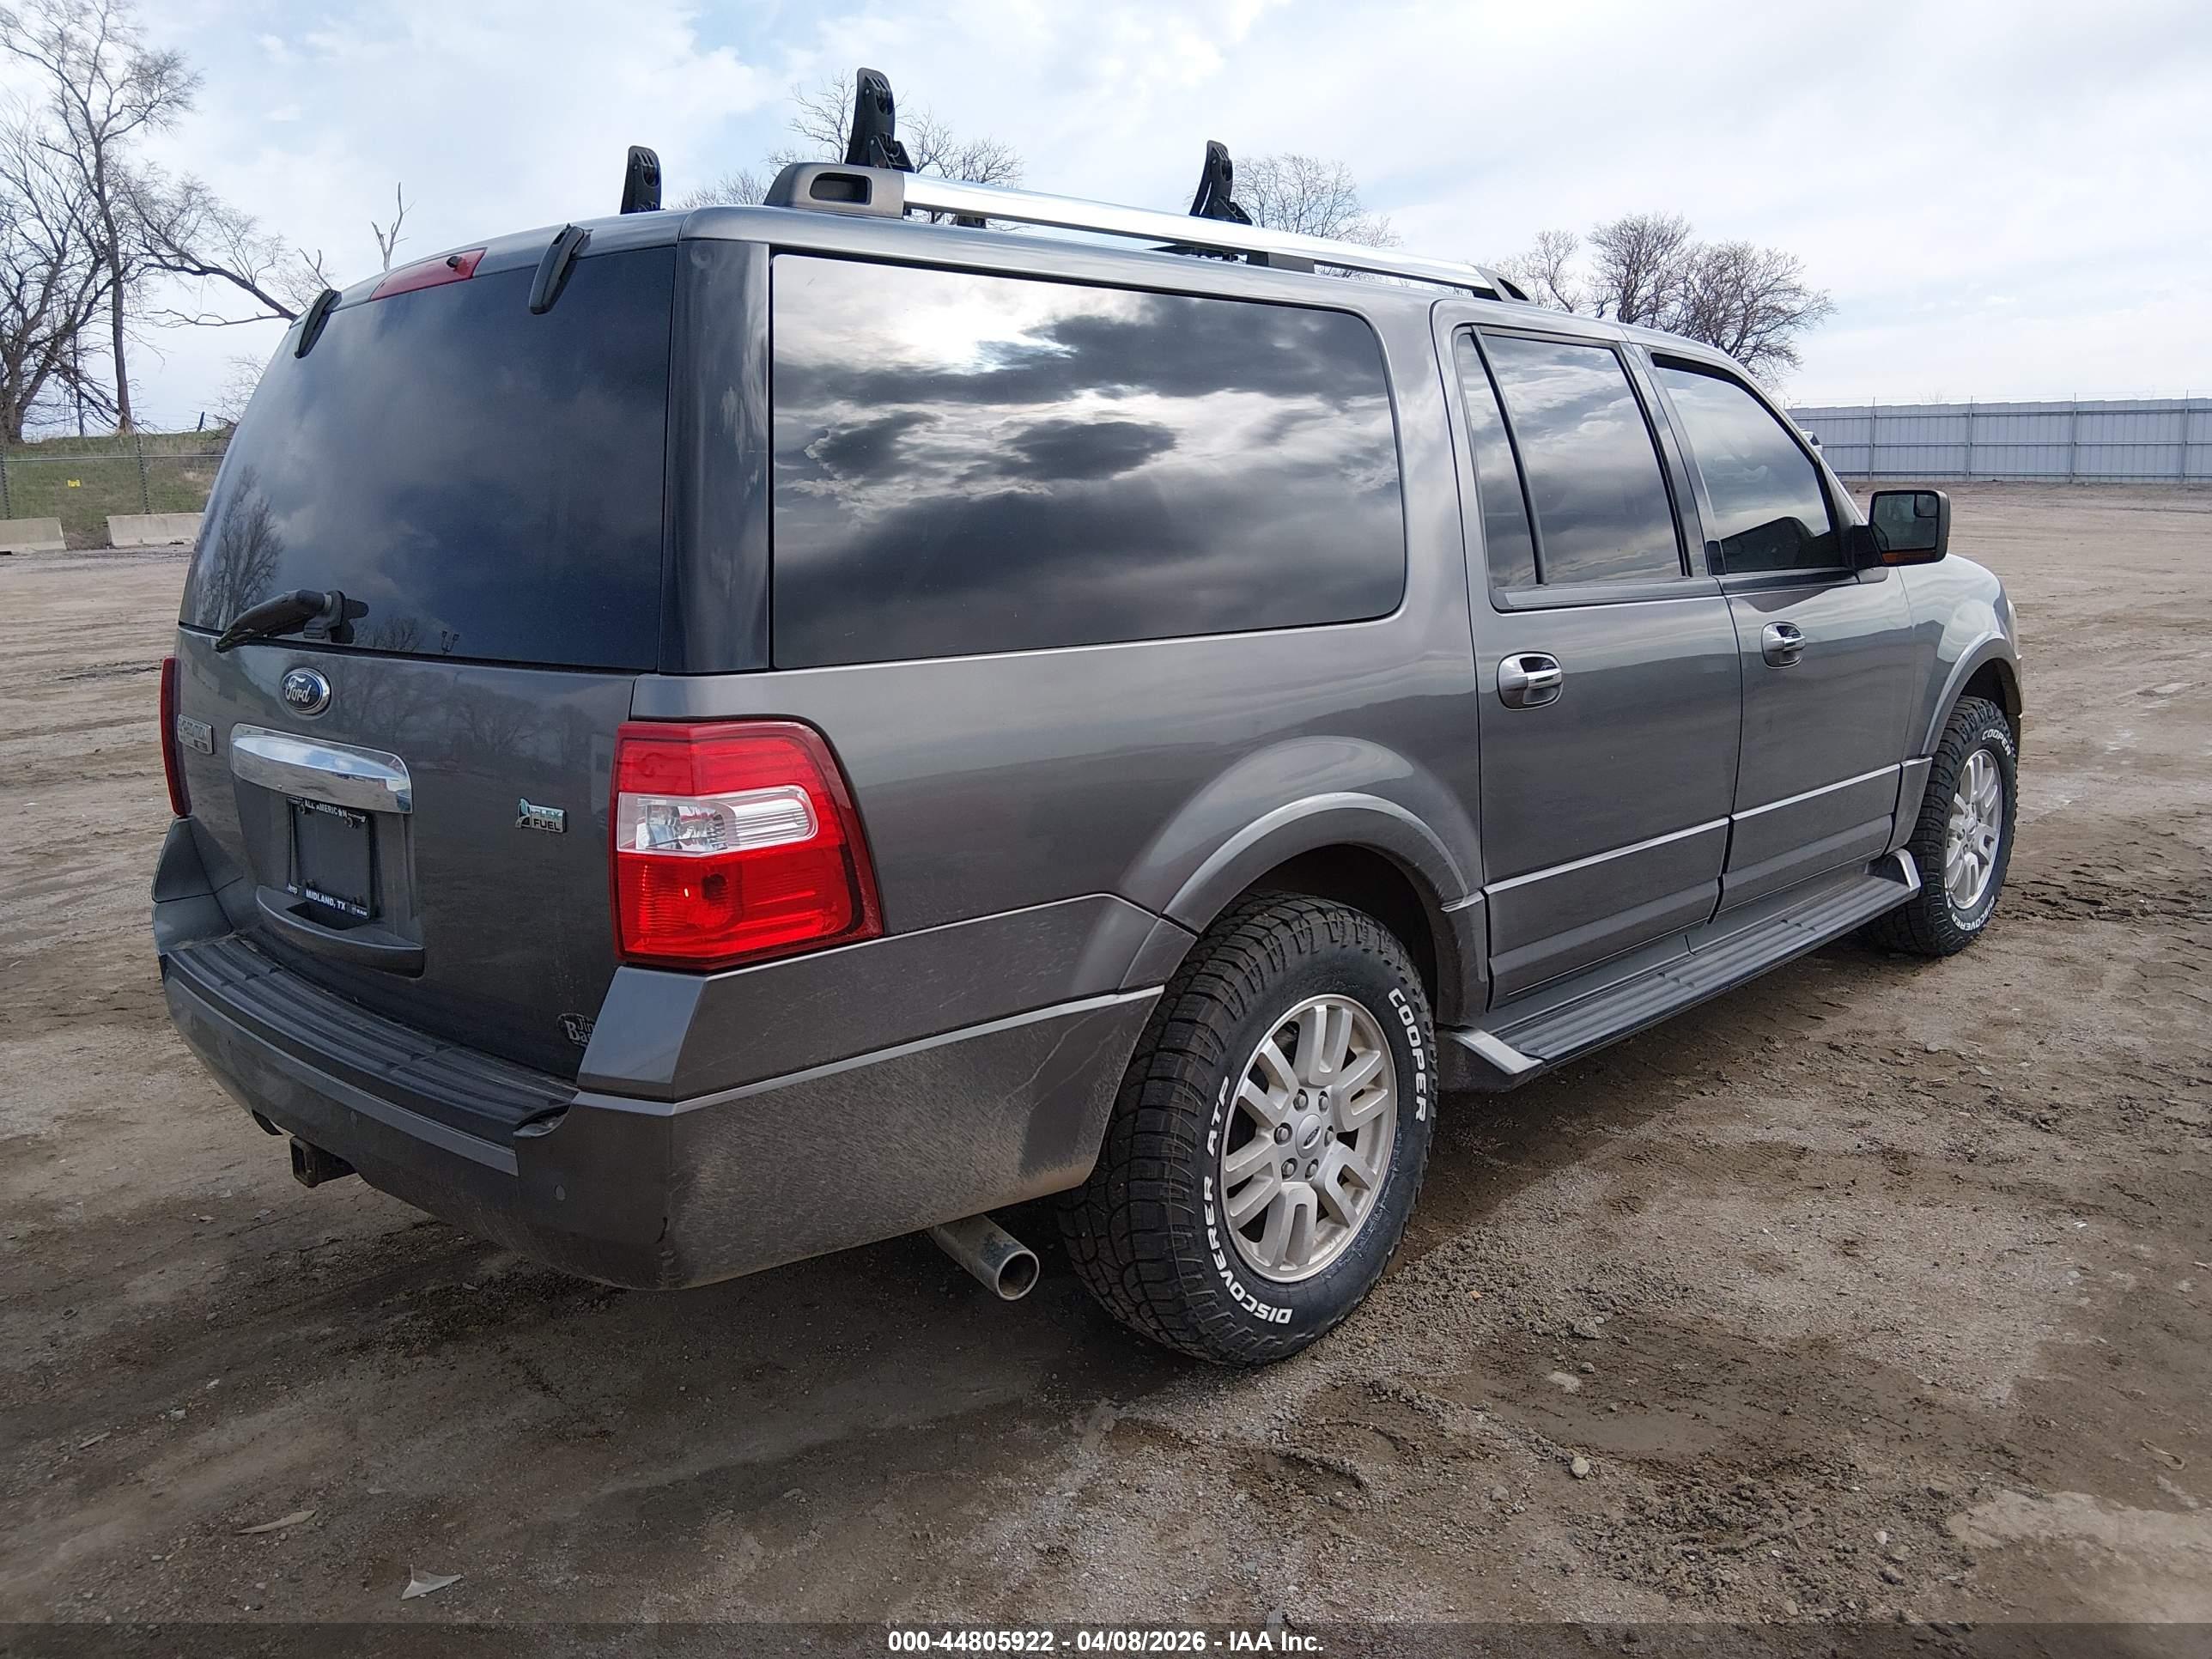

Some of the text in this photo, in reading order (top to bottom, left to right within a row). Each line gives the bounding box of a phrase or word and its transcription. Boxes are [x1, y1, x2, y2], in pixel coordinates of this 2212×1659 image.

[285, 675, 312, 702] Ford
[1982, 728, 2011, 757] COOPER
[304, 799, 315, 810] ALL
[533, 818, 560, 830] FUEL
[288, 883, 298, 895] Jeep
[306, 889, 346, 910] MIDLAND, TX
[1951, 894, 1995, 931] DISCOVERER
[1389, 988, 1428, 1122] COOPER
[1203, 1076, 1293, 1324] DISCOVERER ATP
